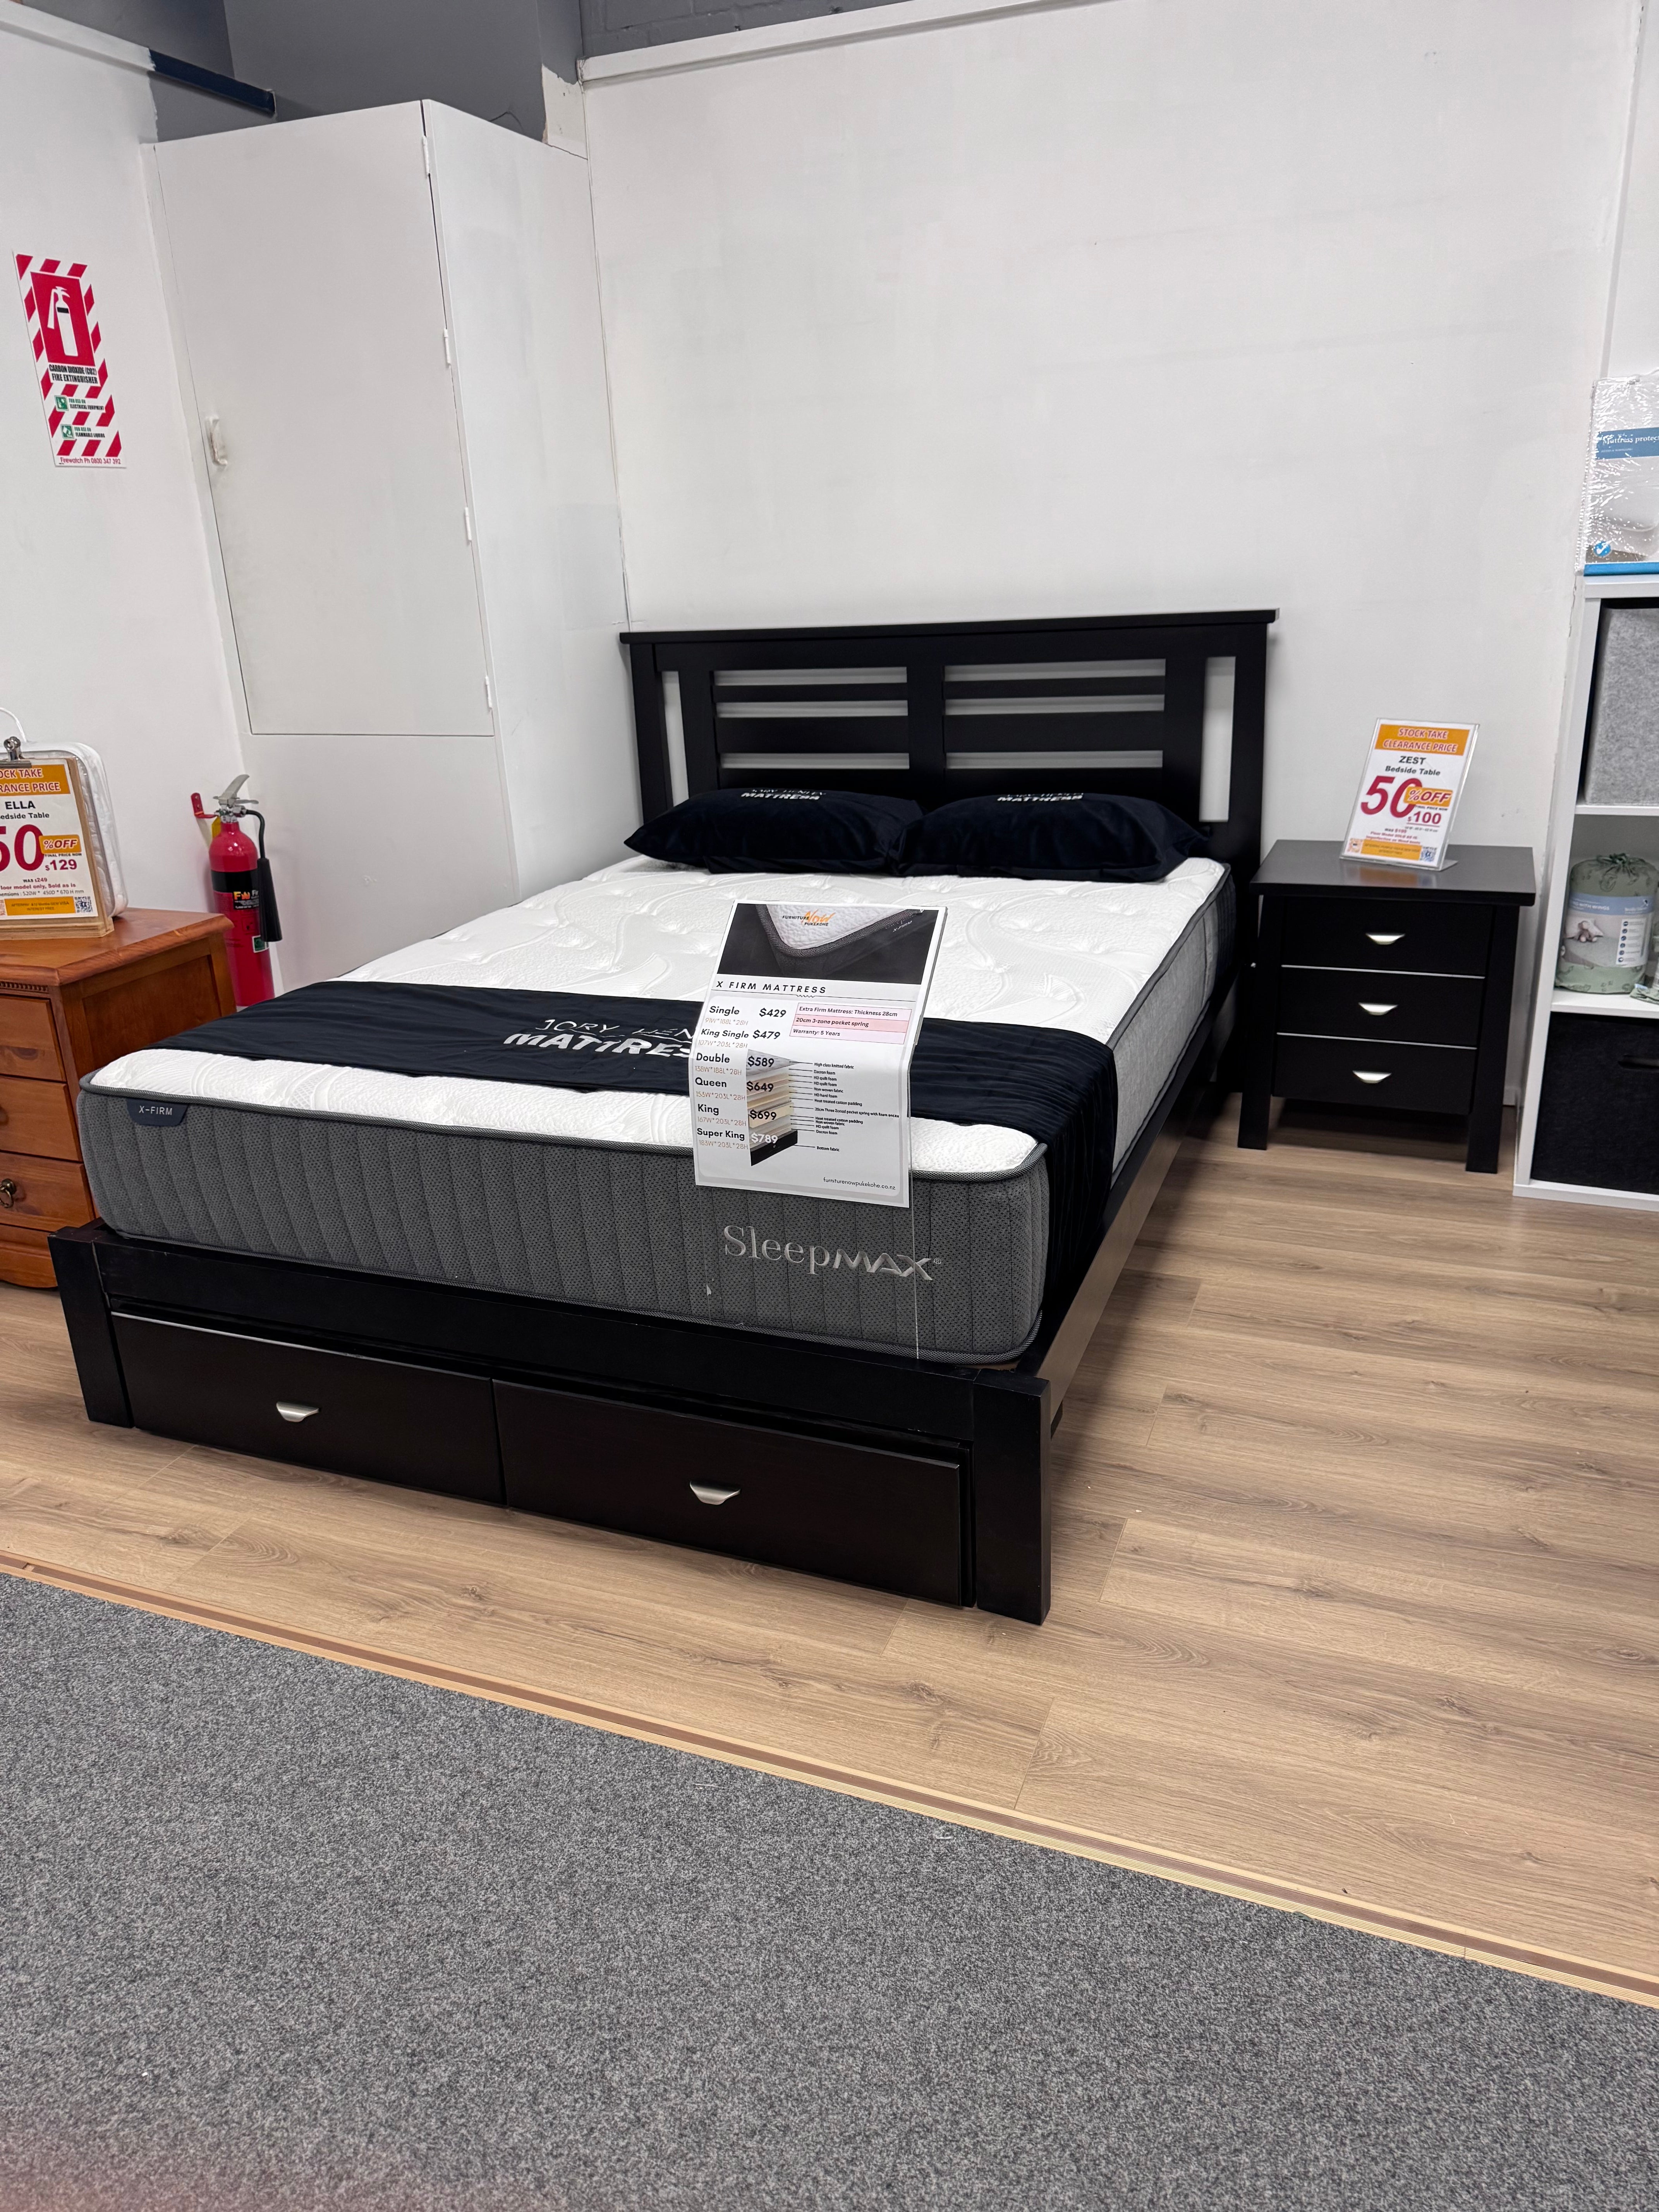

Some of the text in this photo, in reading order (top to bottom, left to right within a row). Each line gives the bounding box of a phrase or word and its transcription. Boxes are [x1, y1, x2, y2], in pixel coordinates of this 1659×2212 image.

[49, 364, 67, 373] CARBON
[67, 366, 85, 374] DIOXIDE
[63, 374, 98, 384] EXTINGUISHER
[1399, 728, 1448, 739] STOCK TAKE
[1383, 740, 1457, 752] CLEARANCE PRICE
[1399, 756, 1426, 765] ZEST
[19, 769, 42, 777] TAKE
[1385, 765, 1417, 774] Bedside
[33, 783, 60, 791] PRICE
[1360, 775, 1452, 818] 50 %OFF
[5, 801, 36, 809] ELLA
[1408, 811, 1441, 824] $100
[44, 840, 77, 849] %OFF
[45, 859, 77, 871] $129
[729, 982, 756, 990] FIRM
[763, 984, 826, 993] MATTRESS
[709, 1006, 787, 1018] Single $429
[535, 1019, 620, 1033] JORY
[701, 1029, 780, 1040] King Single $479
[696, 1053, 775, 1067] Double $589
[695, 1077, 774, 1092] Queen $649
[139, 1106, 172, 1115] X-FIRM
[698, 1104, 776, 1120] King $699
[697, 1128, 778, 1144] Super King $789
[823, 1177, 896, 1190] furniturenowpukekohe.co.nz
